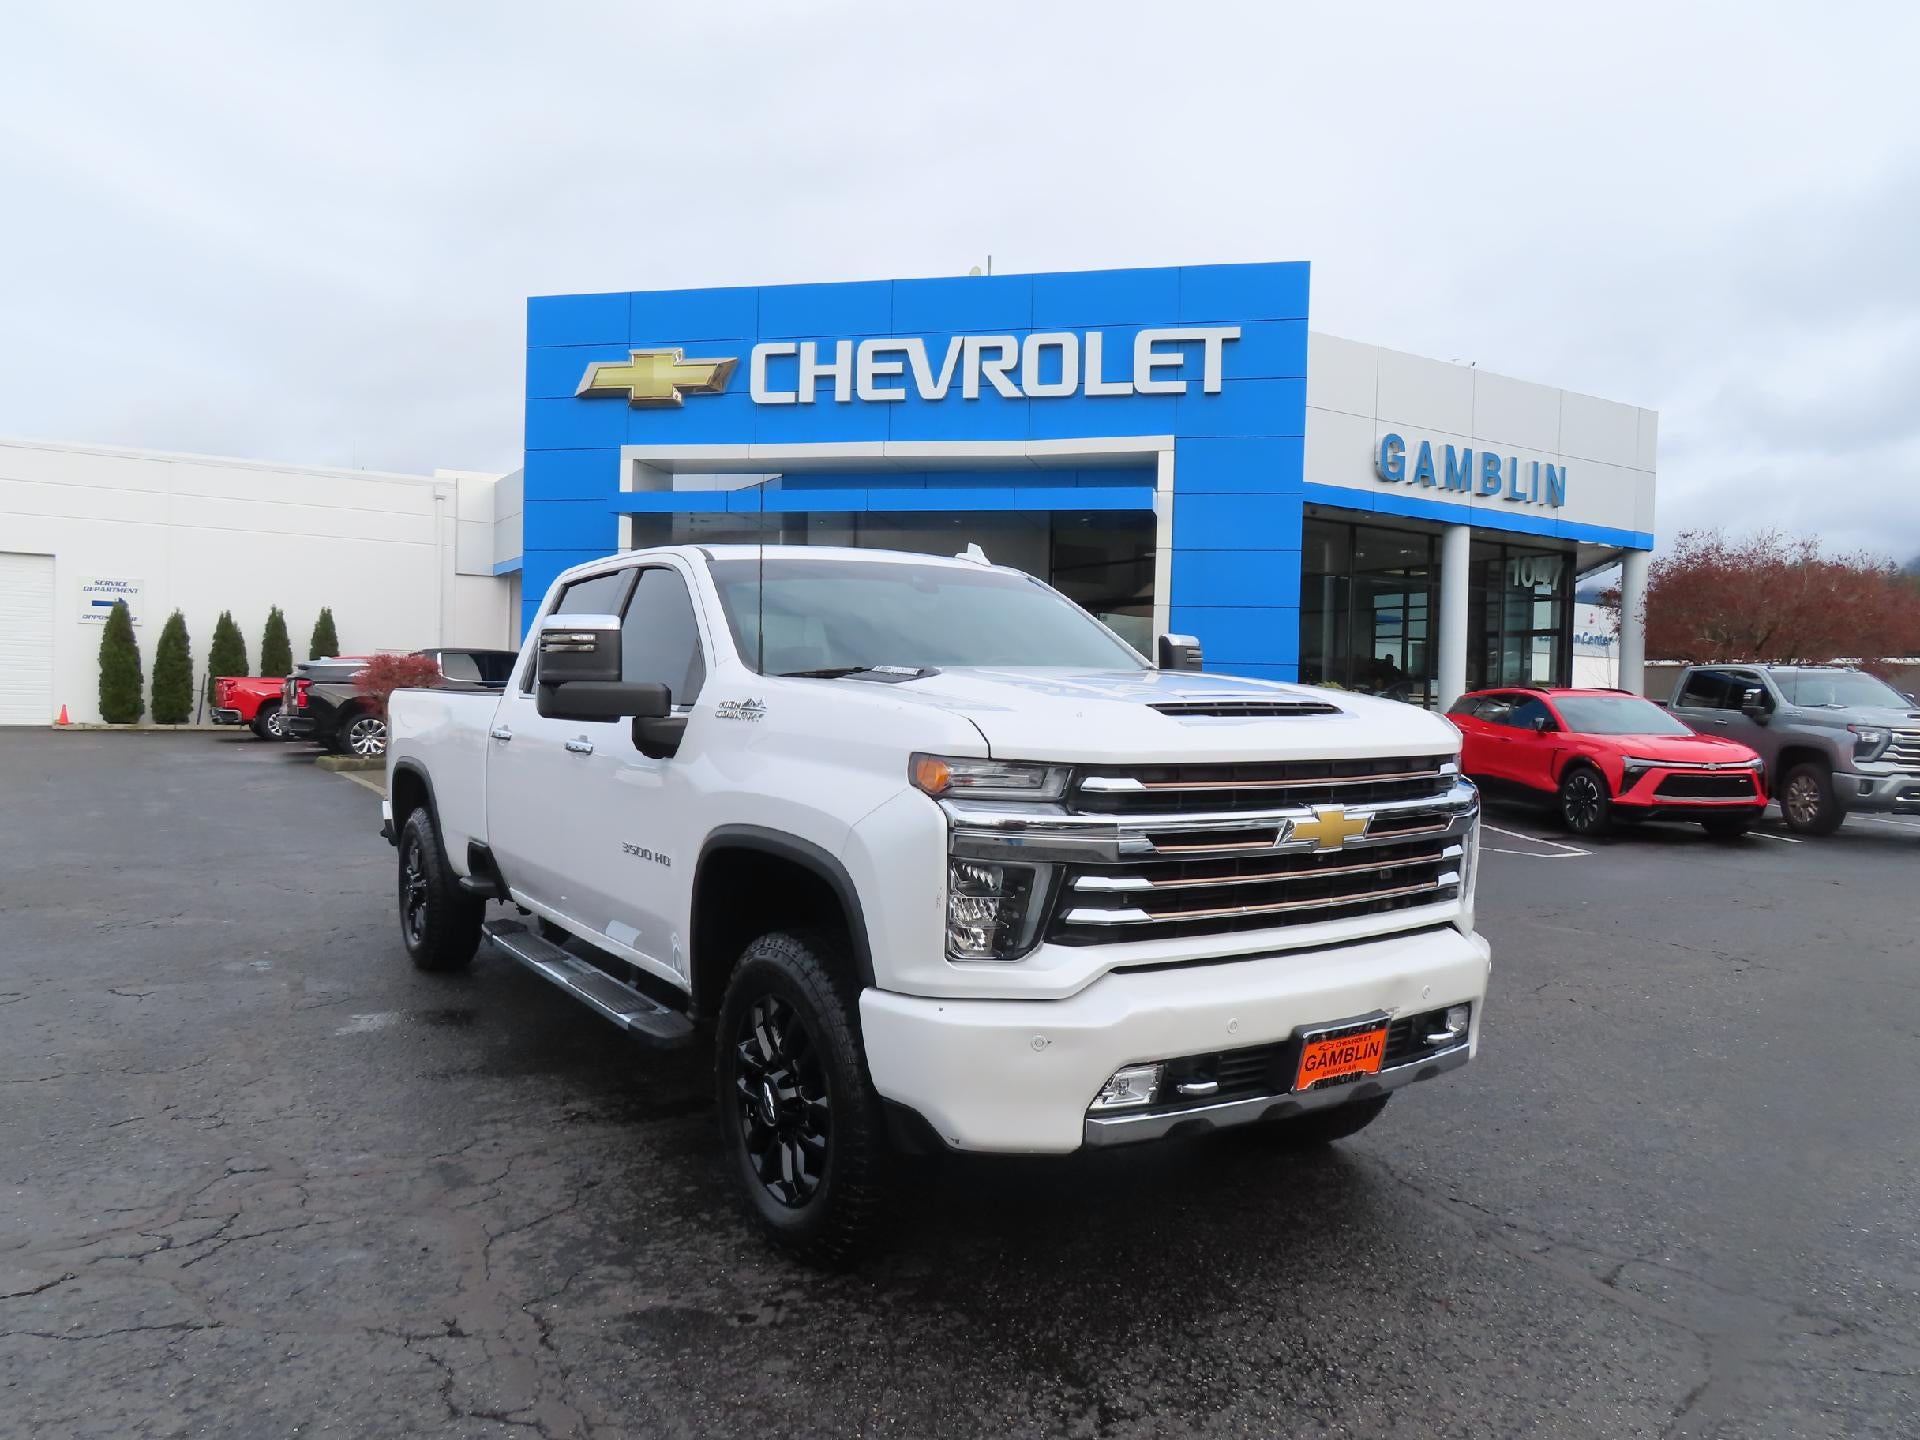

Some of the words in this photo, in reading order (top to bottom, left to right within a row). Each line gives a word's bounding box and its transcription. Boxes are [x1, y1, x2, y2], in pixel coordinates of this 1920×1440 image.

[749, 326, 1242, 405] CHEVROLET
[1375, 432, 1567, 508] GAMBLIN
[83, 586, 139, 594] DEPARTMENT
[94, 579, 129, 587] SERVICE
[622, 841, 652, 861] 3500
[654, 852, 672, 868] HD
[1304, 1040, 1380, 1072] GAMBLIN
